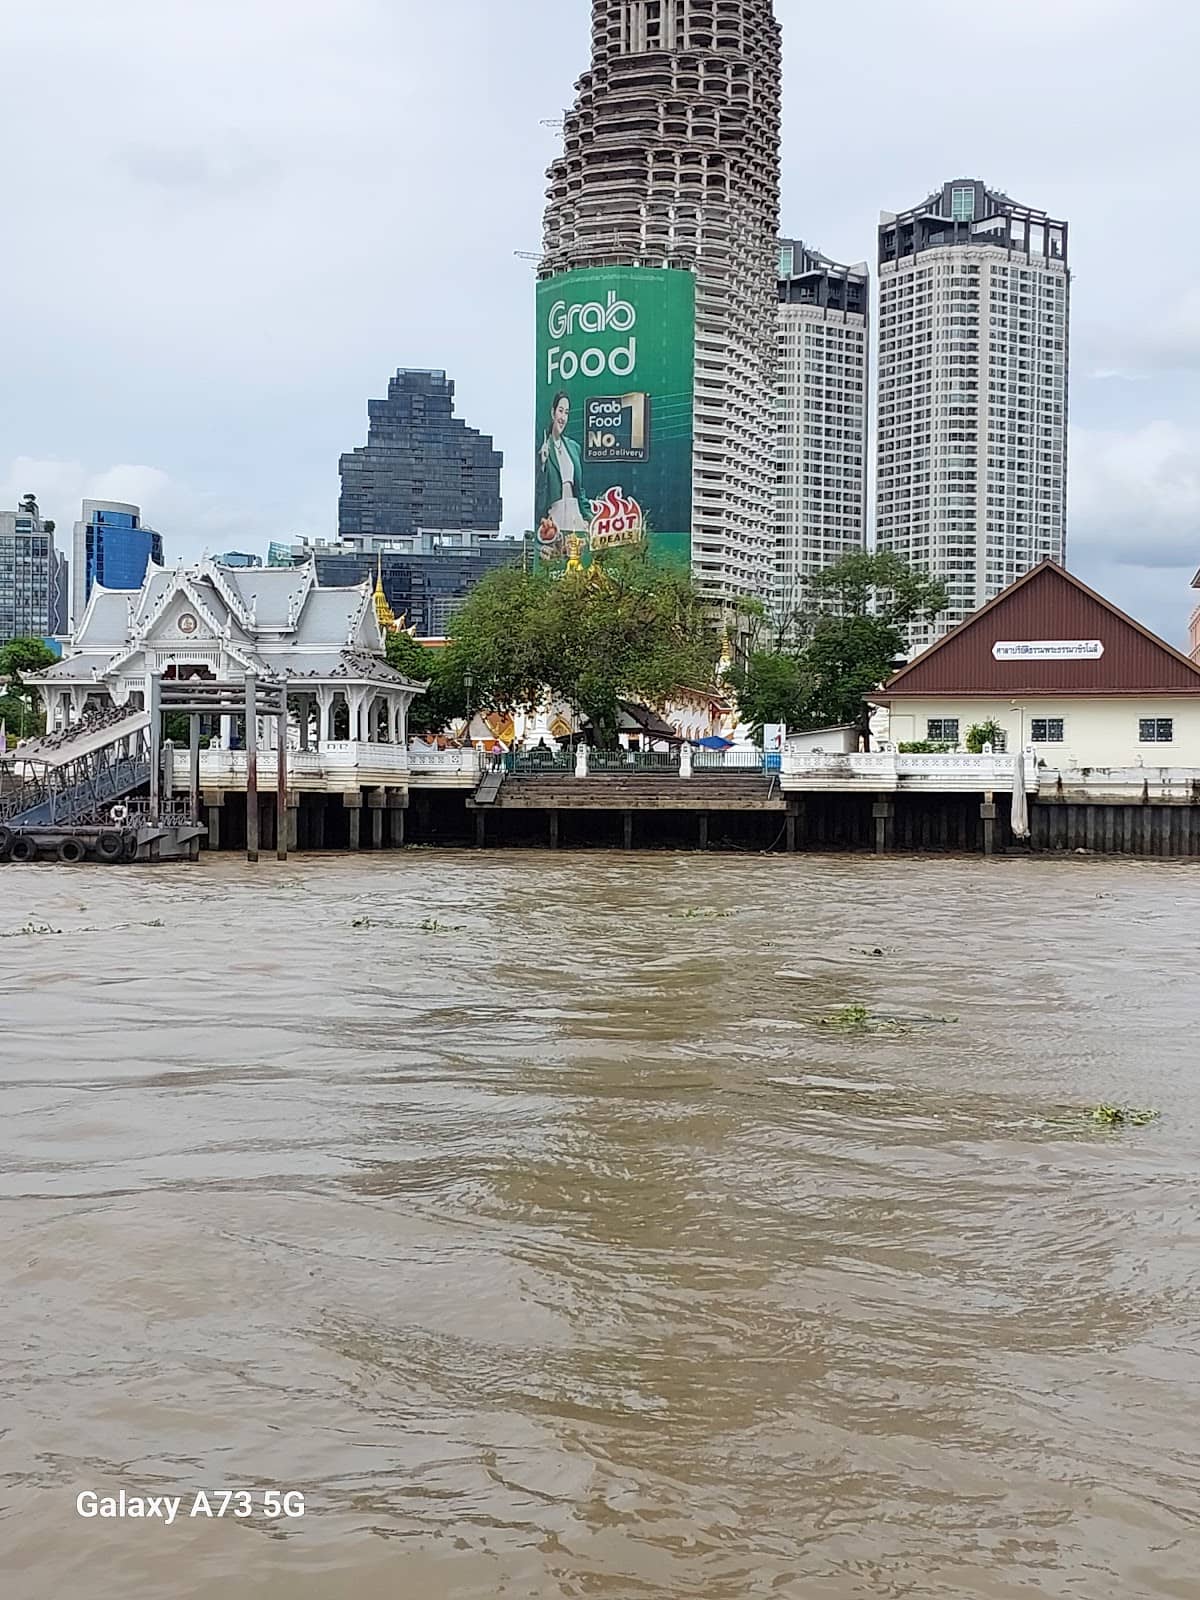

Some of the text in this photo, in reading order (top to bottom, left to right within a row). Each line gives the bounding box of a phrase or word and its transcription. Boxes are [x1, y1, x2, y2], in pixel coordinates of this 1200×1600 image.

[549, 290, 636, 339] Grab
[547, 337, 636, 384] Food
[590, 400, 621, 414] Grab
[588, 392, 645, 449] No. 1
[589, 414, 622, 427] Food
[588, 448, 644, 459] Food Delivery
[598, 515, 637, 535] HOT
[599, 531, 633, 545] DEALS
